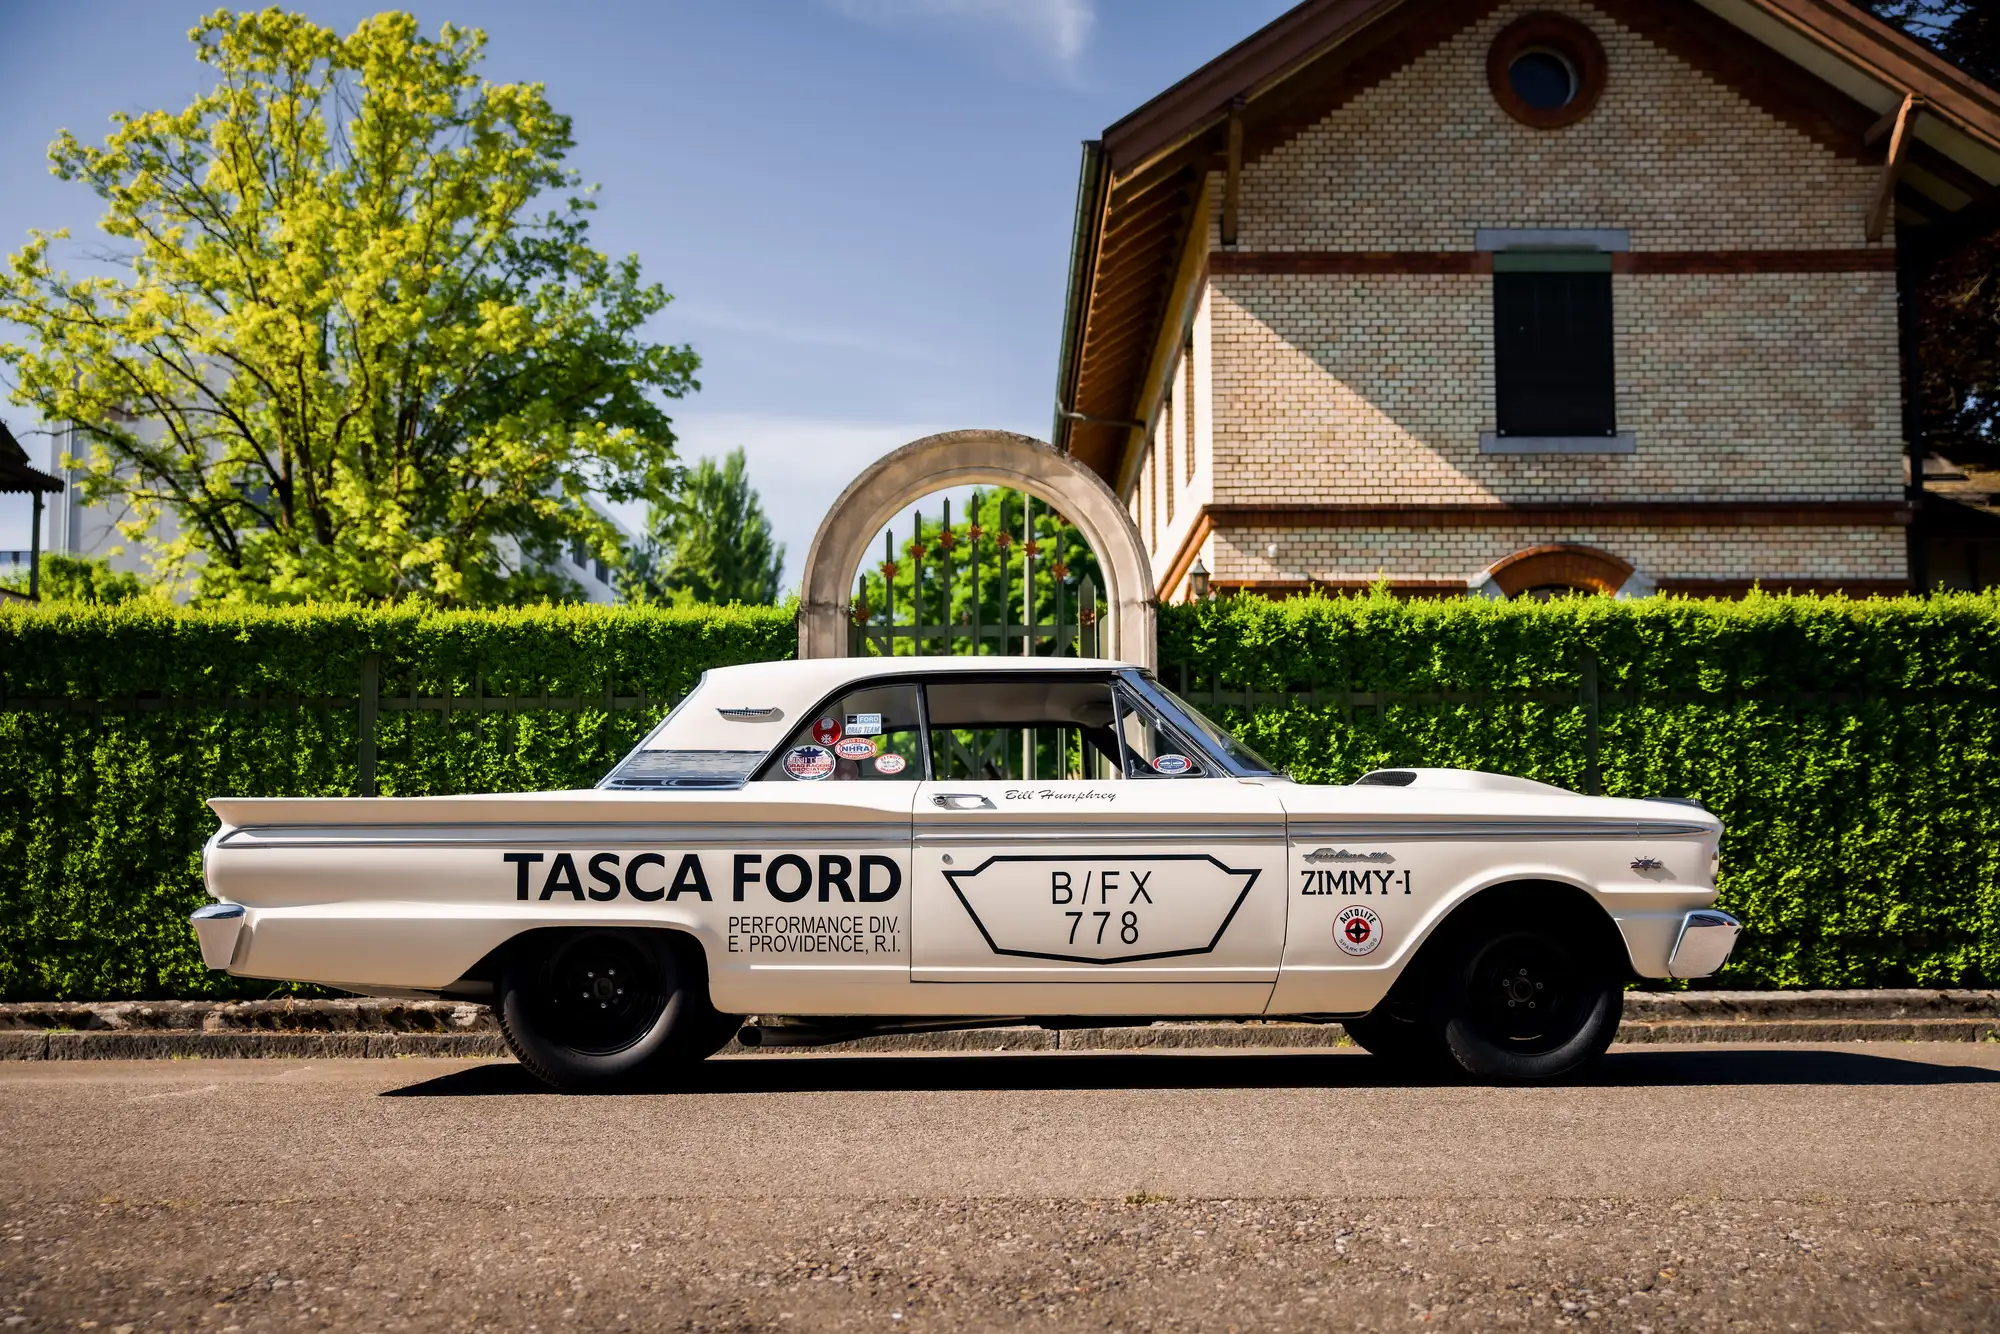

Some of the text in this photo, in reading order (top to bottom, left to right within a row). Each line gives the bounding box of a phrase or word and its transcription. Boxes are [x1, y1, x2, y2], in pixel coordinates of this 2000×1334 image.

[847, 725, 880, 734] DRAG TEAM
[787, 756, 832, 764] UNITED
[1004, 789, 1117, 803] Bill Humphrey
[503, 853, 901, 903] TASCA FORD
[1339, 908, 1377, 924] AUTOLITE
[729, 916, 901, 934] PERFORMANCE DIV.
[1065, 910, 1139, 945] 778
[729, 935, 901, 955] E. PROVIDENCE, R.I.
[1338, 937, 1378, 953] SPARK PLUGS
